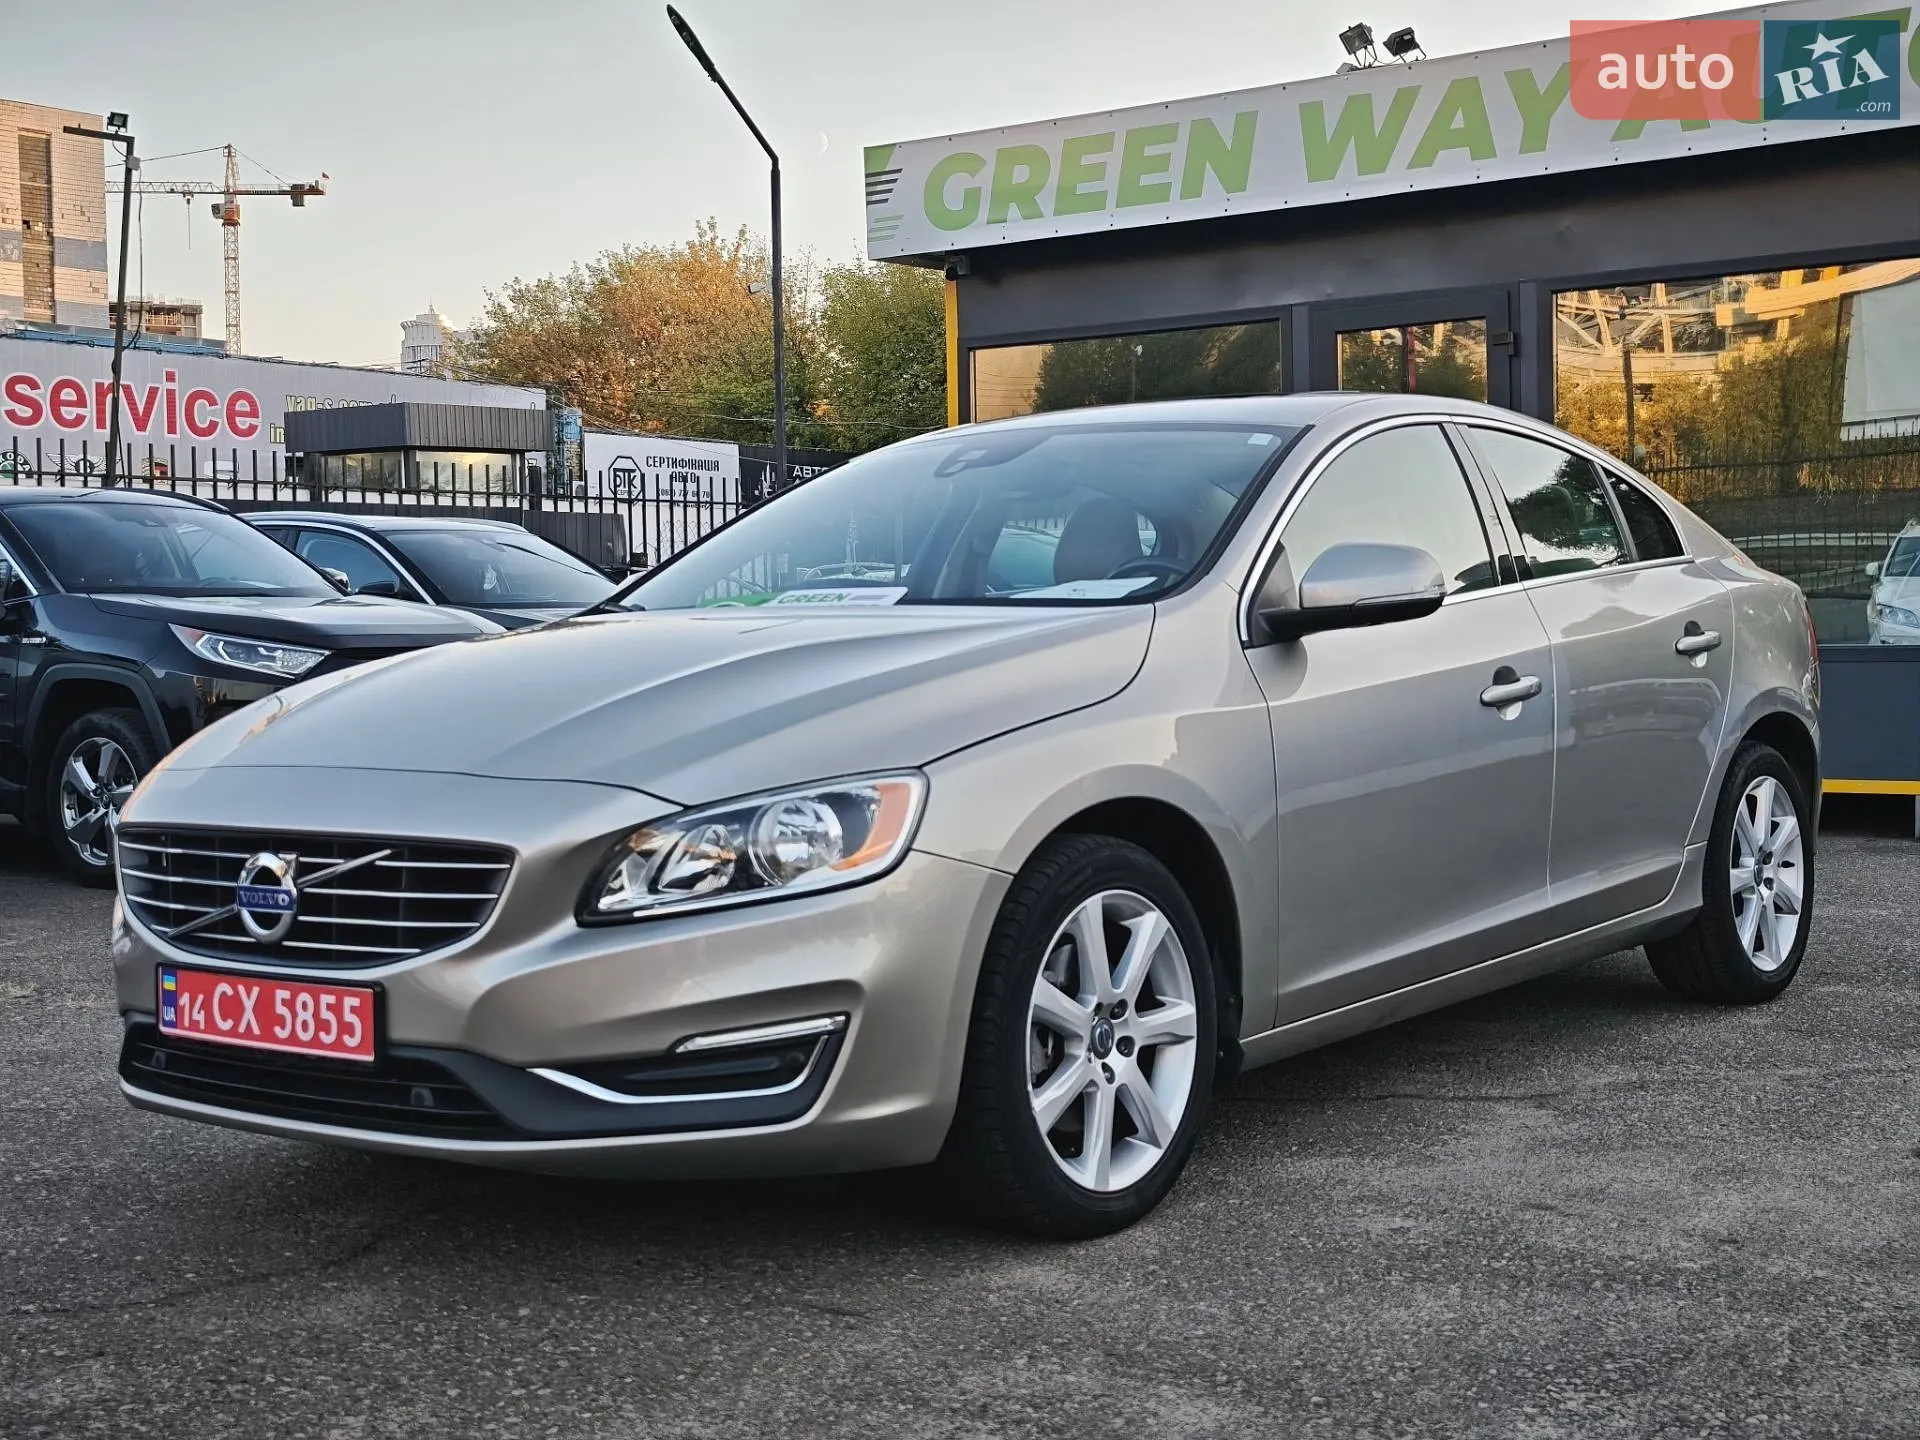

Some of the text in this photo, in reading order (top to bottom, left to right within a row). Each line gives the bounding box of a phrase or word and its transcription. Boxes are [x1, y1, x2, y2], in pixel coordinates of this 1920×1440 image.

[923, 7, 1920, 232] GREEN WAY AUT
[2, 368, 262, 440] service
[671, 470, 697, 483] АВТО
[793, 465, 830, 478] АВТ
[777, 592, 851, 604] GREEN
[240, 890, 290, 906] VOLVO
[163, 1005, 176, 1022] UA
[179, 982, 362, 1048] 14 CX 5855
